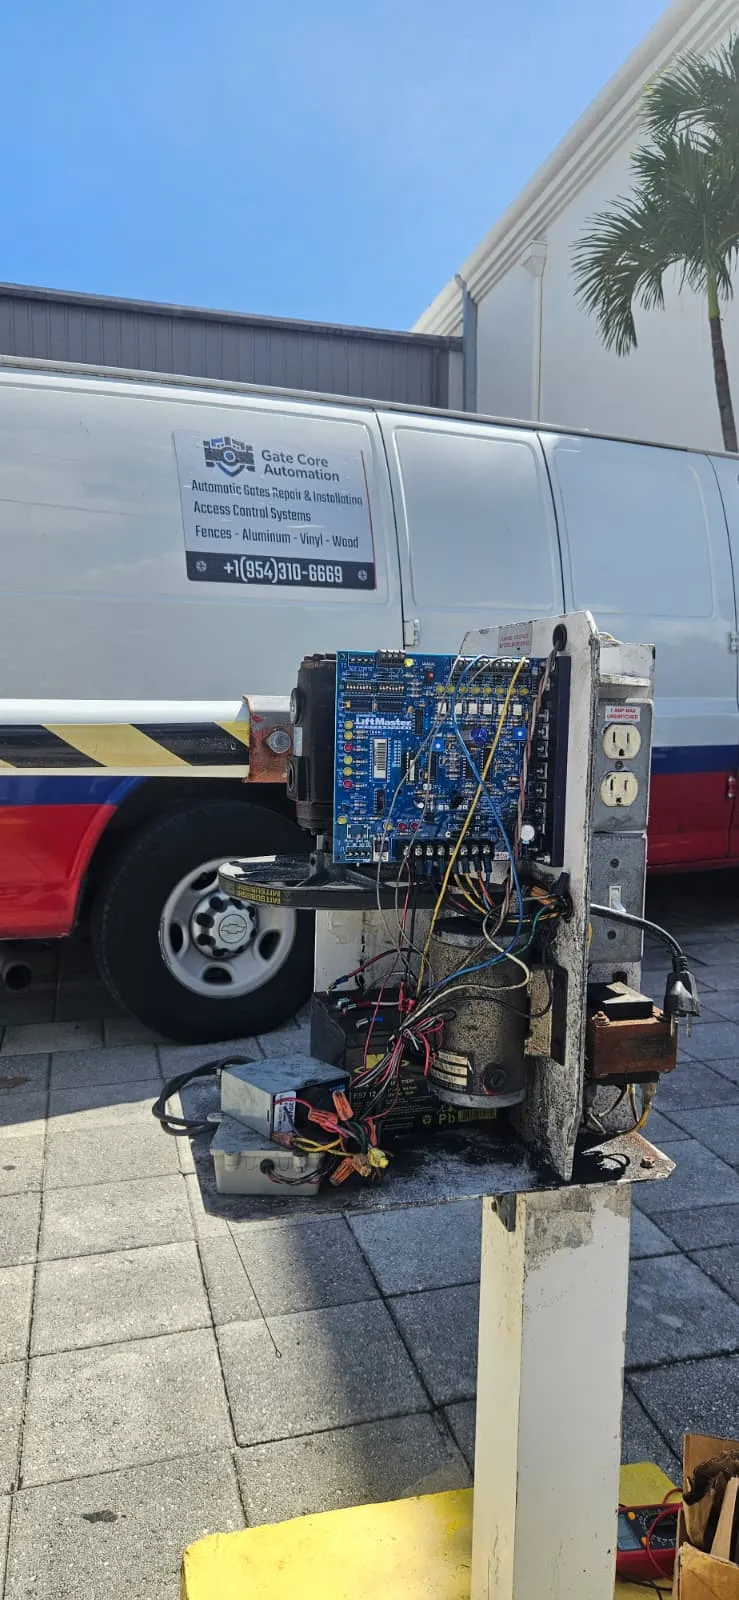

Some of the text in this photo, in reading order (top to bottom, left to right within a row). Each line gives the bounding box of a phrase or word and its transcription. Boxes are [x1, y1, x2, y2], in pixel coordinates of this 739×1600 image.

[261, 450, 329, 468] Gate Core
[264, 464, 340, 482] Automation
[191, 480, 363, 506] Automatic Gates Repair & Installation
[193, 501, 311, 522] Access Control Systems
[195, 525, 232, 540] Fences
[242, 528, 291, 544] Aluminum
[300, 532, 323, 548] Vinyl
[332, 535, 359, 549] Wood
[223, 556, 343, 584] +1(954)310-6669
[355, 717, 412, 726] LiftMaster
